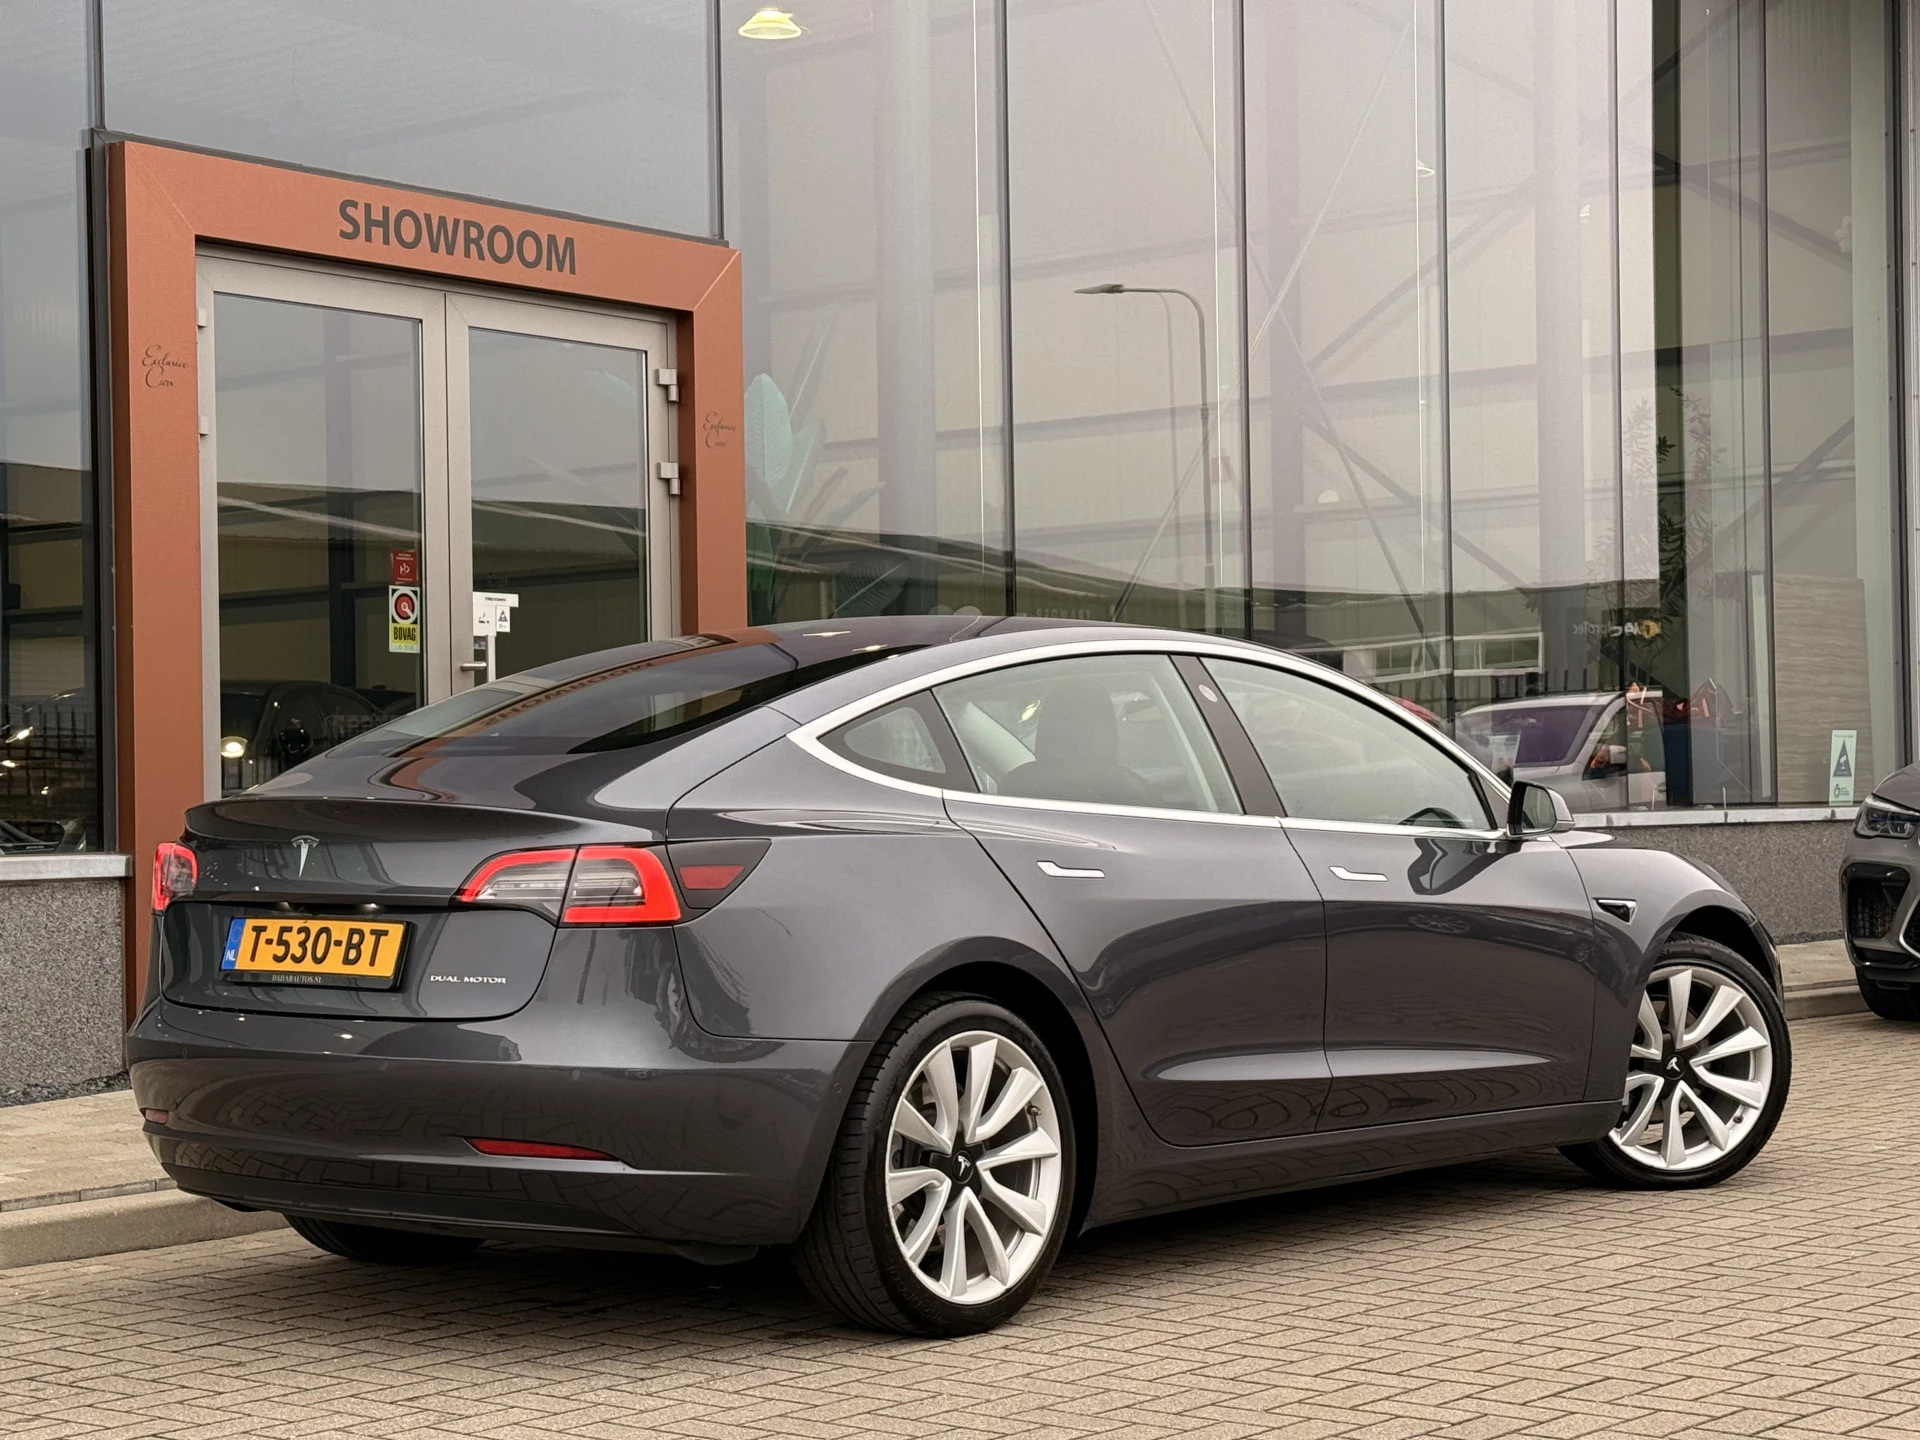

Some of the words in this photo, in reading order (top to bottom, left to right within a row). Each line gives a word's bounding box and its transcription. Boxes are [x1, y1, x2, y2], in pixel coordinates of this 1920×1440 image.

[339, 199, 576, 275] SHOWROOM
[393, 626, 416, 641] BOVAG
[249, 925, 389, 967] T-530-BT
[225, 949, 236, 961] NL
[430, 975, 461, 983] DUAL
[464, 976, 507, 984] MOTOR
